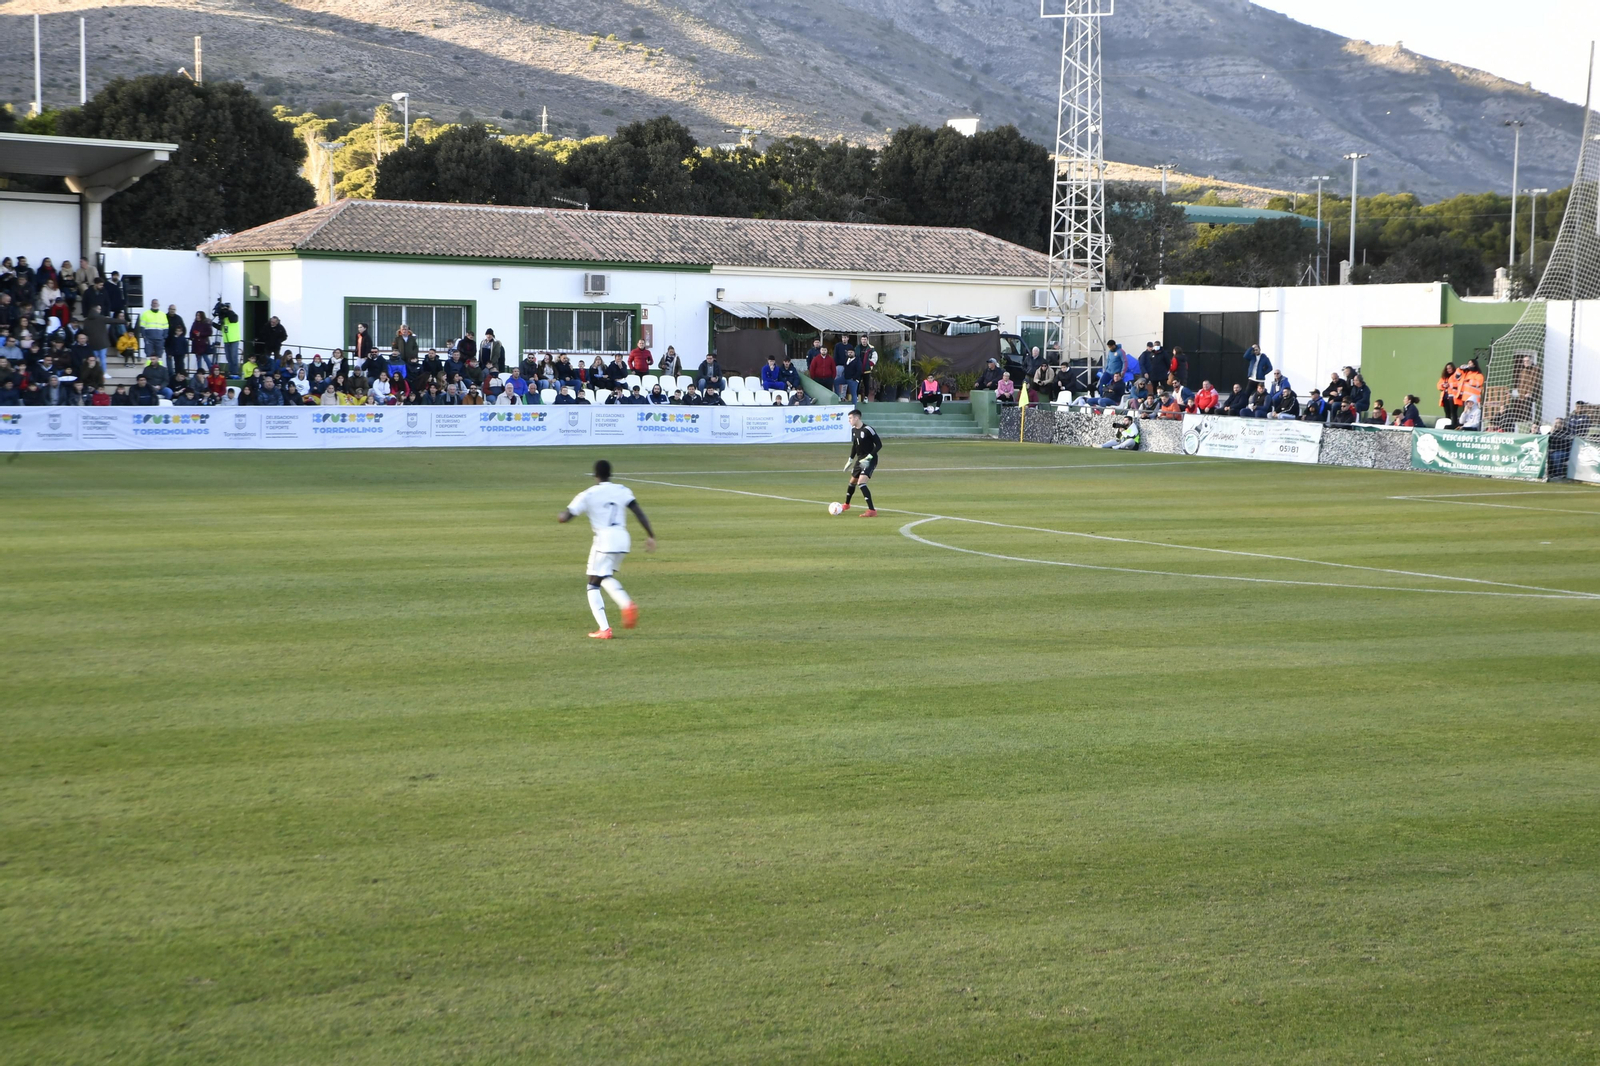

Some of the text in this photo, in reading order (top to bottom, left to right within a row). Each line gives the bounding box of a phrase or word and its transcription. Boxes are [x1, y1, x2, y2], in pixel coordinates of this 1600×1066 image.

[637, 425, 699, 433] TORREMOLINOS
[785, 424, 843, 433] TORREMOLINOS
[1248, 428, 1265, 436] bizum
[1442, 434, 1474, 442] PESCADOS
[1480, 436, 1514, 445] MARISCOS
